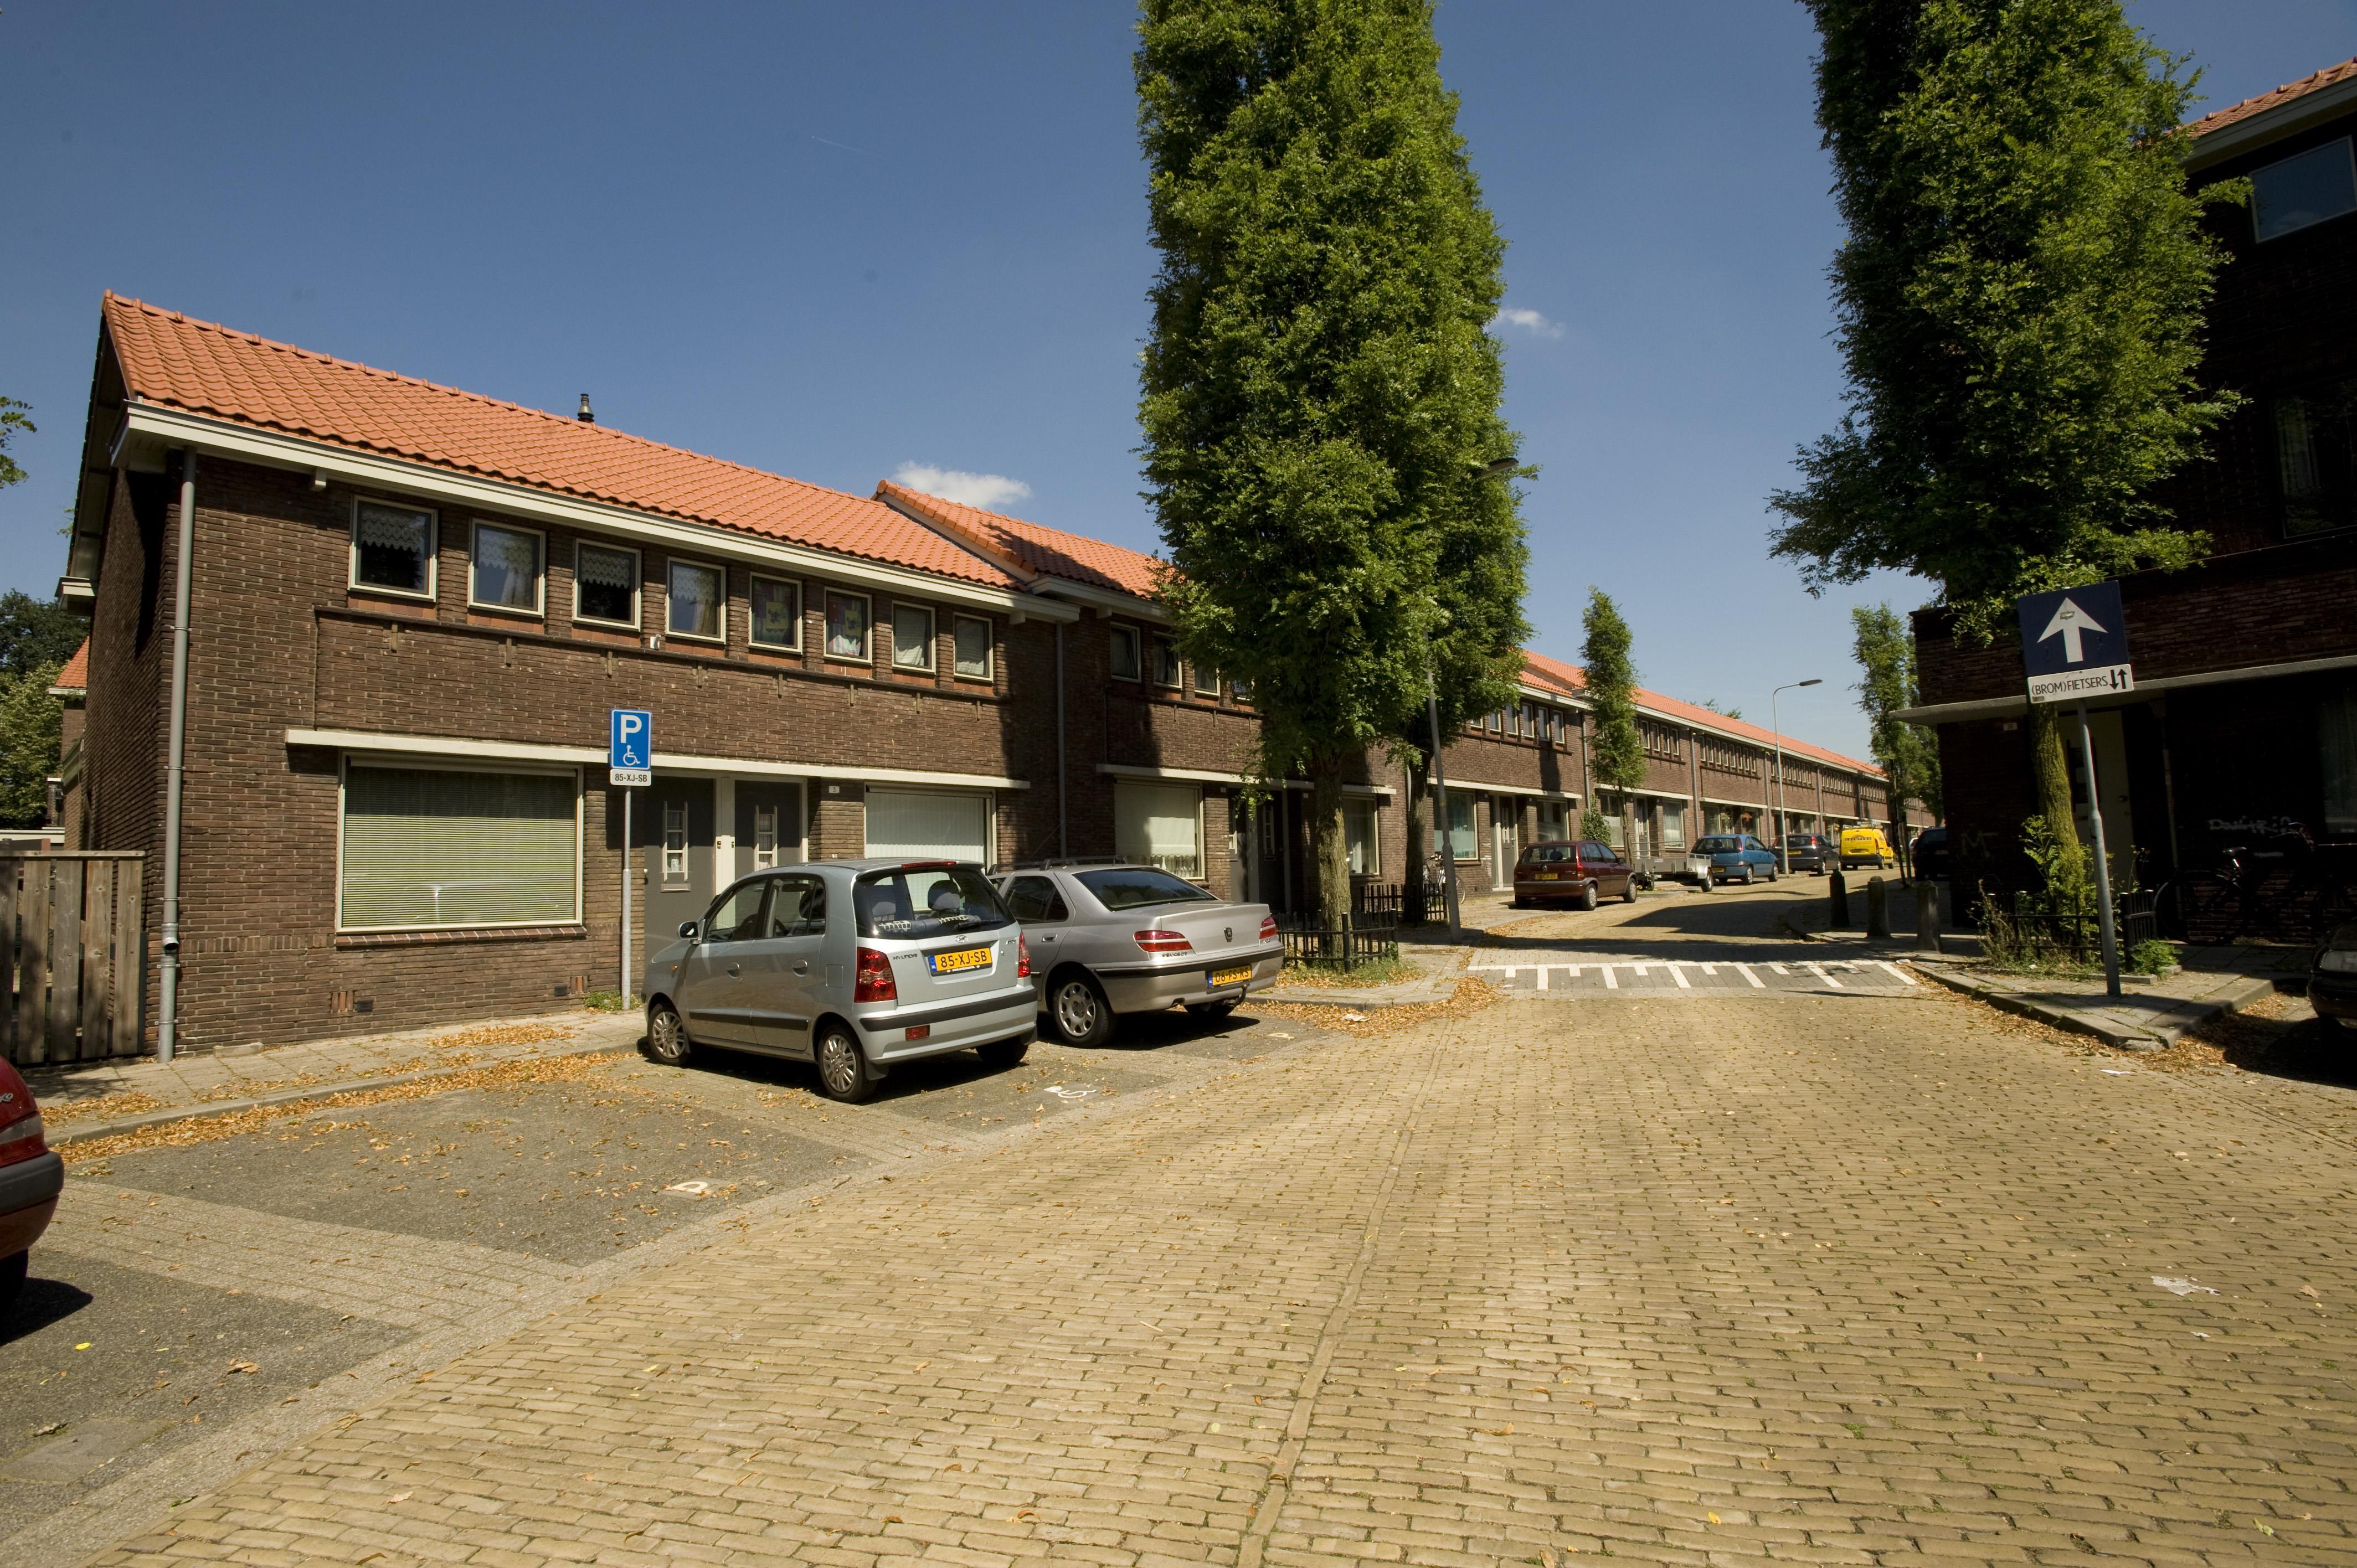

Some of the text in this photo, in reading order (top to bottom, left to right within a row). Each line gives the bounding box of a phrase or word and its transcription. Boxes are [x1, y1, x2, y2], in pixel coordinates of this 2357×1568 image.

[2031, 675, 2108, 695] (BROM)FIETSERS
[620, 714, 642, 744] P
[615, 773, 647, 782] 85-XJ-SB
[940, 951, 987, 968] 85-XJ-SB
[1215, 967, 1249, 983] 06-FS-RS
